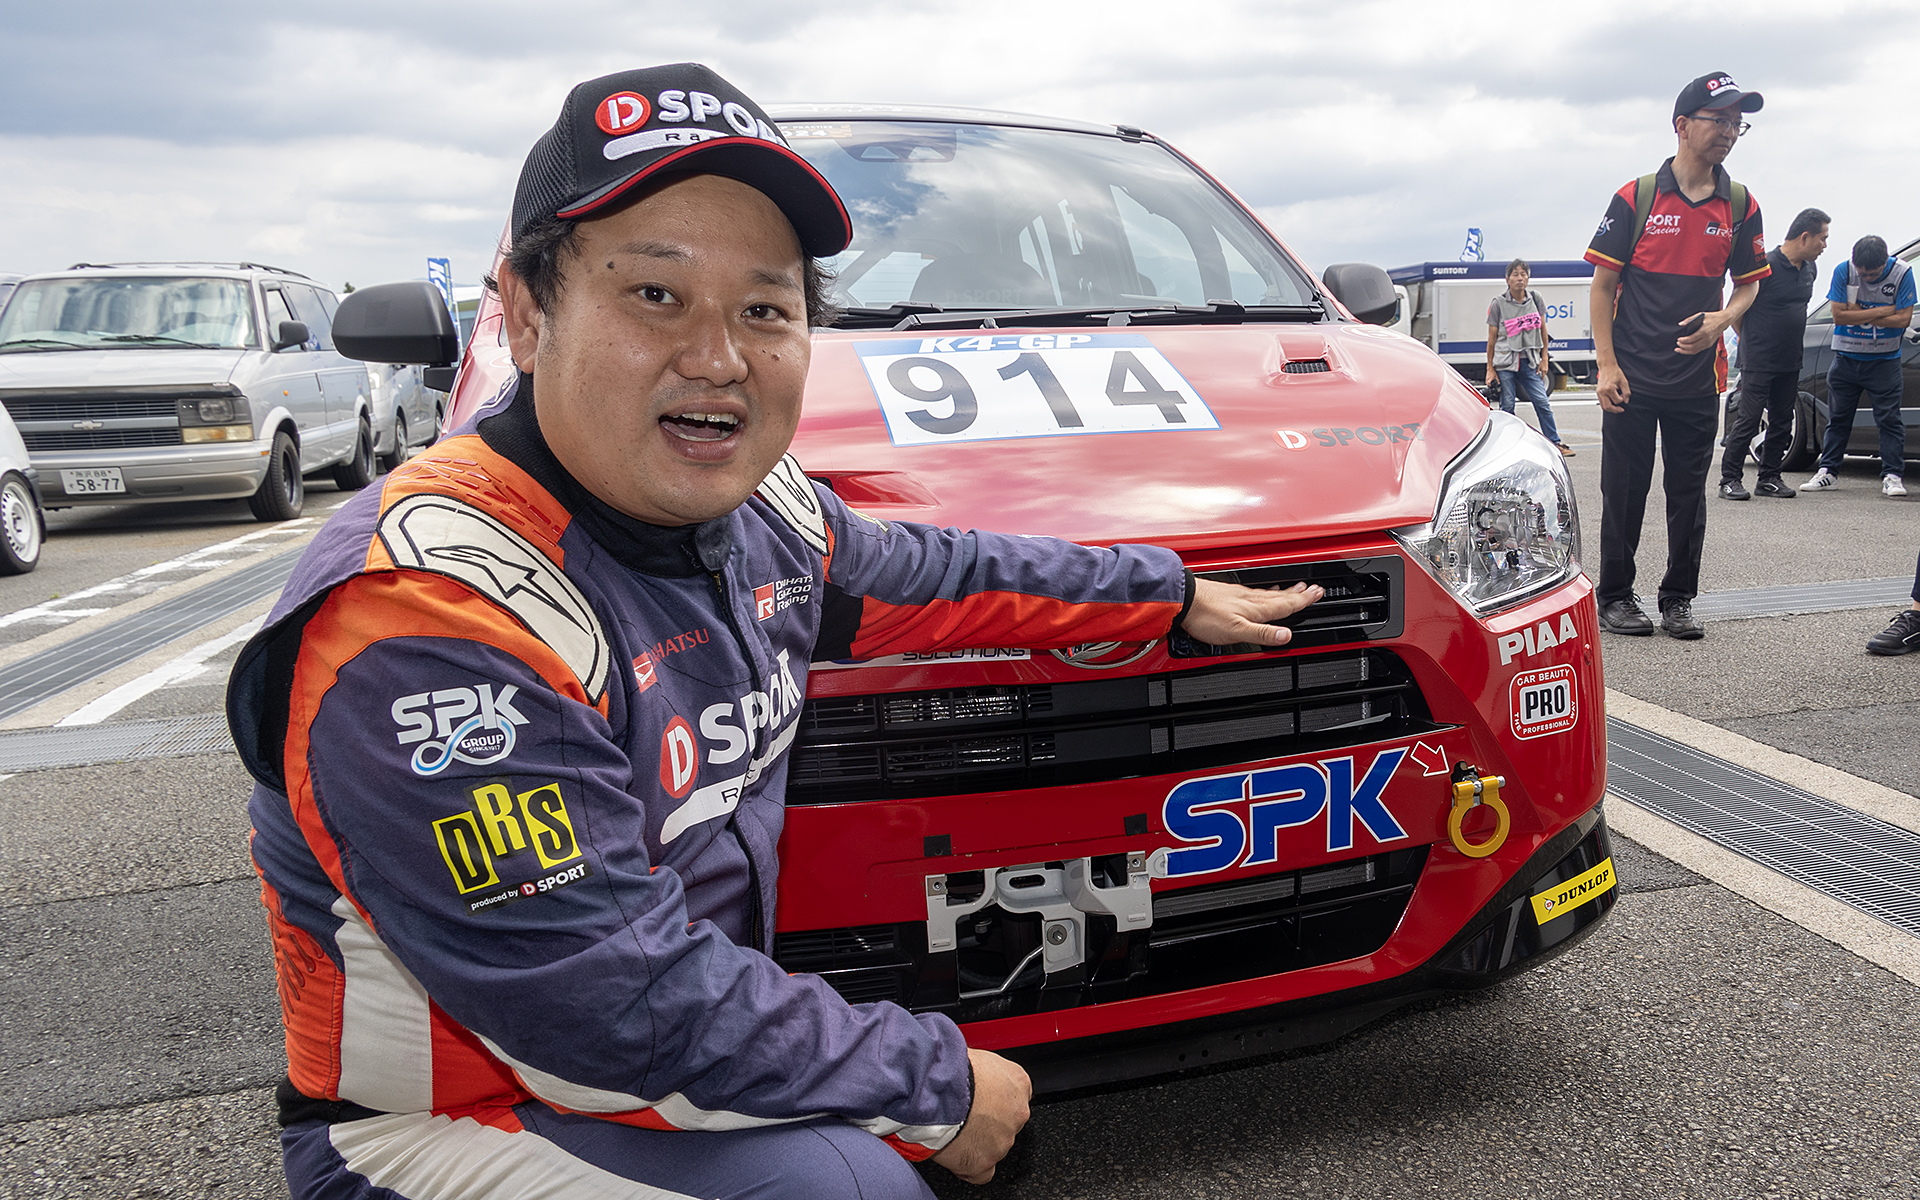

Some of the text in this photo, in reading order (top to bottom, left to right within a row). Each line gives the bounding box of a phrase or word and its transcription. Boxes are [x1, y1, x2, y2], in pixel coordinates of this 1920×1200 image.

[1646, 213, 1682, 227] PORT
[1432, 267, 1469, 275] SUNTORY
[1545, 301, 1574, 323] psi
[918, 333, 1092, 353] K4-GP
[1547, 341, 1568, 349] ERVICE
[886, 351, 1188, 434] 914
[1312, 422, 1425, 447] SPORT
[76, 478, 120, 492] 58-77
[1497, 612, 1578, 666] PIAA
[1516, 668, 1570, 687] CAR BEAUTY
[1525, 684, 1566, 720] PRO
[391, 683, 531, 745] SPK
[1522, 719, 1570, 735] PROFESSIONAL
[460, 734, 505, 749] GROUP
[1162, 745, 1410, 879] SPK
[434, 783, 579, 891] DRS
[470, 892, 508, 911] produced
[508, 888, 519, 899] by
[536, 863, 587, 893] SPORT
[1557, 868, 1609, 906] DUNLOP
